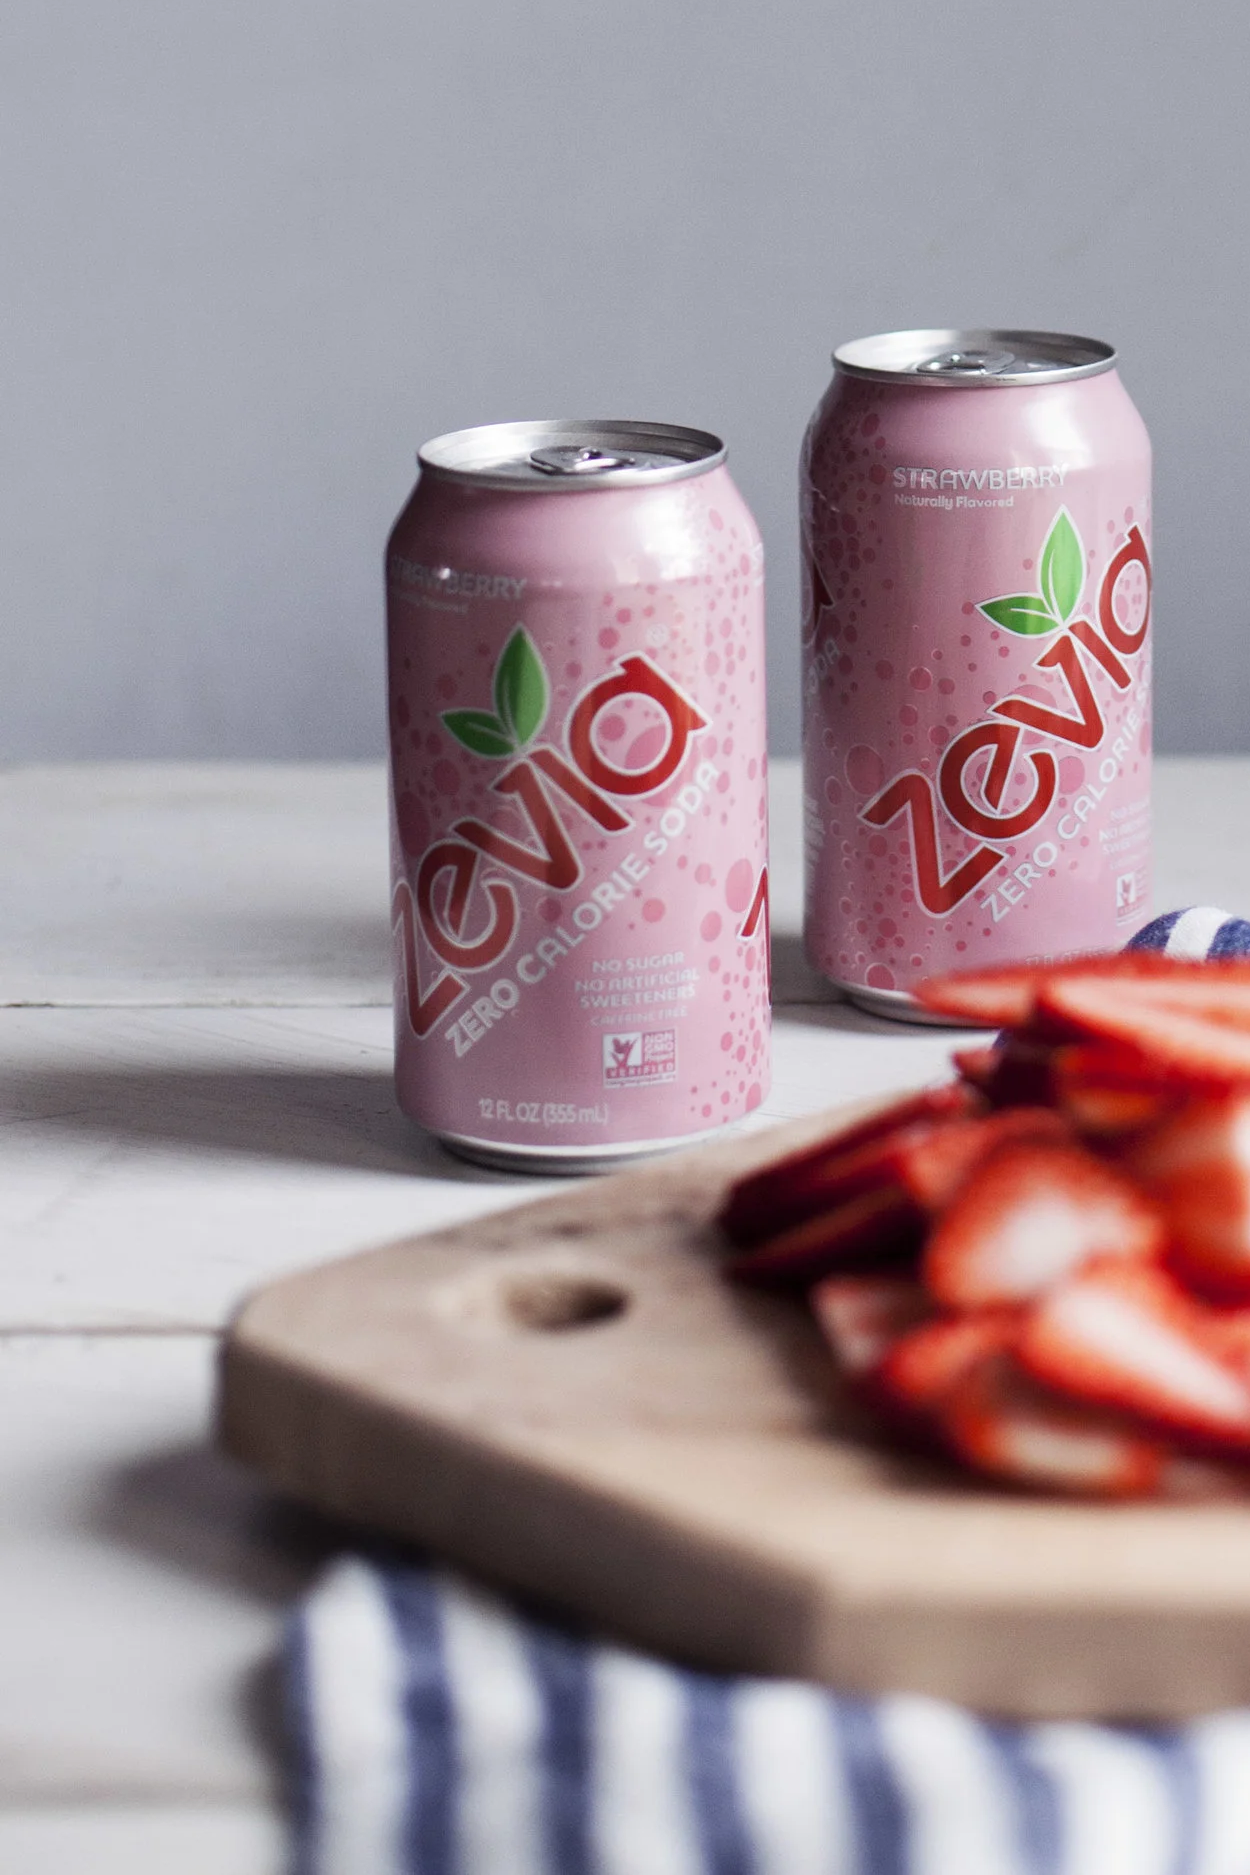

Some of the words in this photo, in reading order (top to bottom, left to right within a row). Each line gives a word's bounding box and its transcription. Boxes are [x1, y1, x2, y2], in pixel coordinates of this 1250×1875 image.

[893, 462, 1070, 491] STRAWBERRY
[894, 493, 954, 511] Naturally
[956, 495, 1014, 508] Flavored
[391, 555, 528, 600] RAWBERRY
[980, 841, 1057, 923] ZERO
[1057, 708, 1141, 840] CALORIE
[444, 978, 520, 1057] ZERO
[516, 852, 650, 984] CALORIE
[643, 761, 719, 856] SODA
[592, 959, 621, 973] NO
[625, 951, 685, 970] SUGAR
[575, 979, 603, 992] NO
[609, 967, 700, 991] ARTIFICIAL
[579, 982, 697, 1010] SWEETENERS
[479, 1098, 494, 1119] 12
[496, 1099, 514, 1121] FL
[515, 1102, 541, 1123] OZ
[543, 1102, 577, 1128] (355
[578, 1103, 608, 1126] mL)
